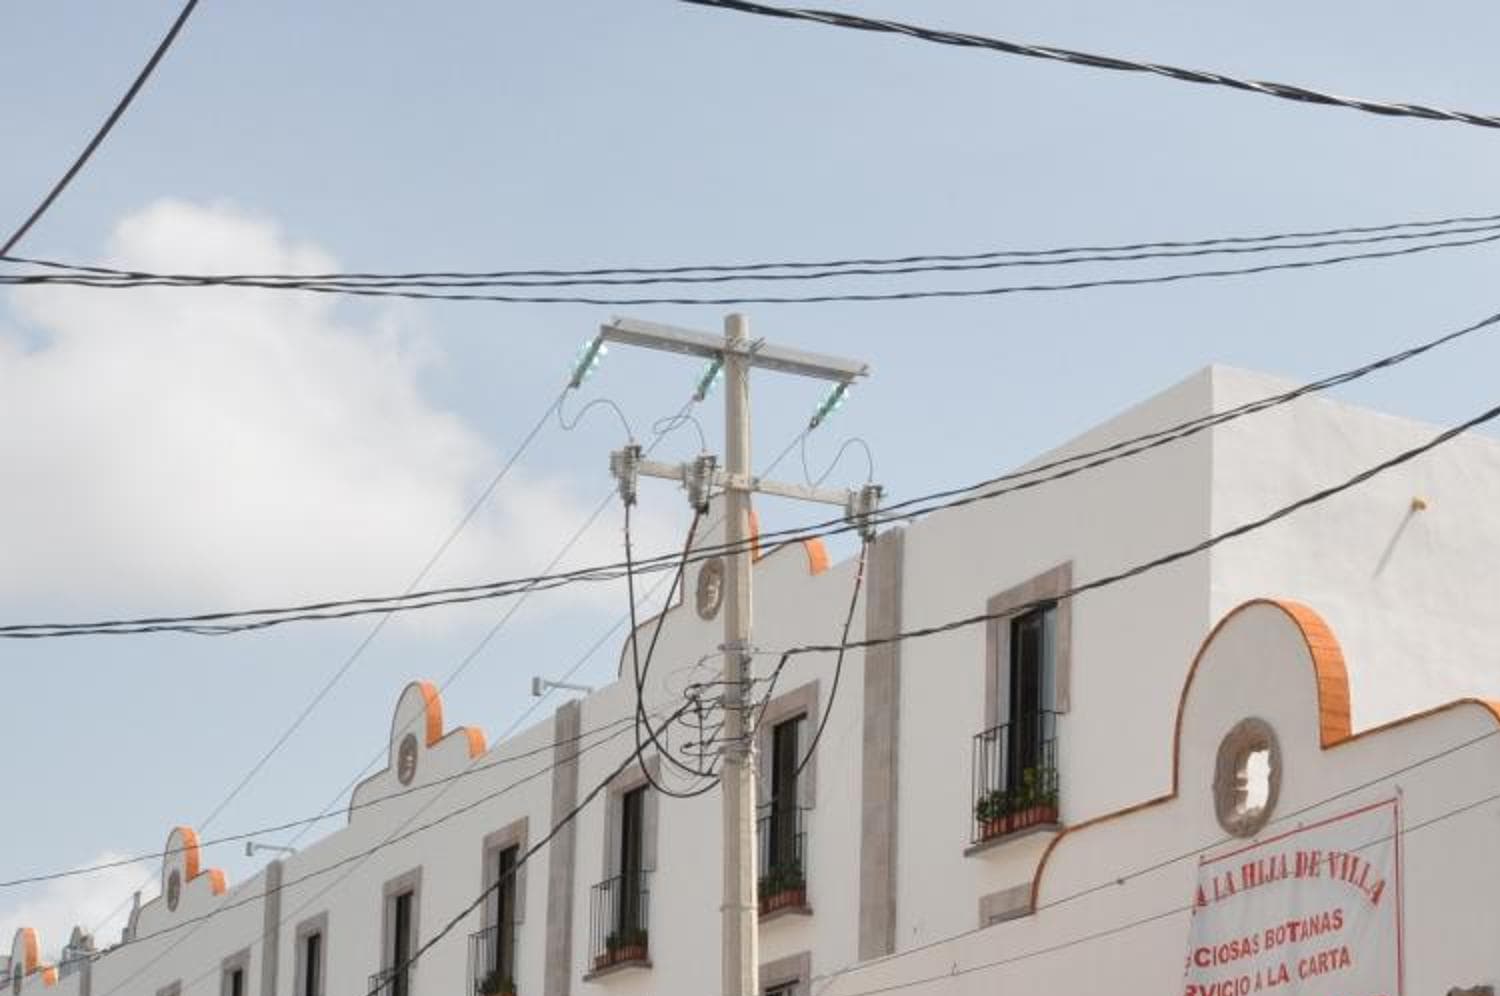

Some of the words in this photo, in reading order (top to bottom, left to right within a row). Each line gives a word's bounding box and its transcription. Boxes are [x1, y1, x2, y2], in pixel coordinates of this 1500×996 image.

[1213, 870, 1236, 902] LA
[1242, 852, 1289, 891] HIJA
[1295, 849, 1321, 879] DE
[1327, 850, 1386, 907] VILLA
[1185, 934, 1260, 974] CIOSAS
[1264, 908, 1344, 950] BOTANAS
[1267, 961, 1291, 988] LA
[1298, 945, 1352, 980] CARTA
